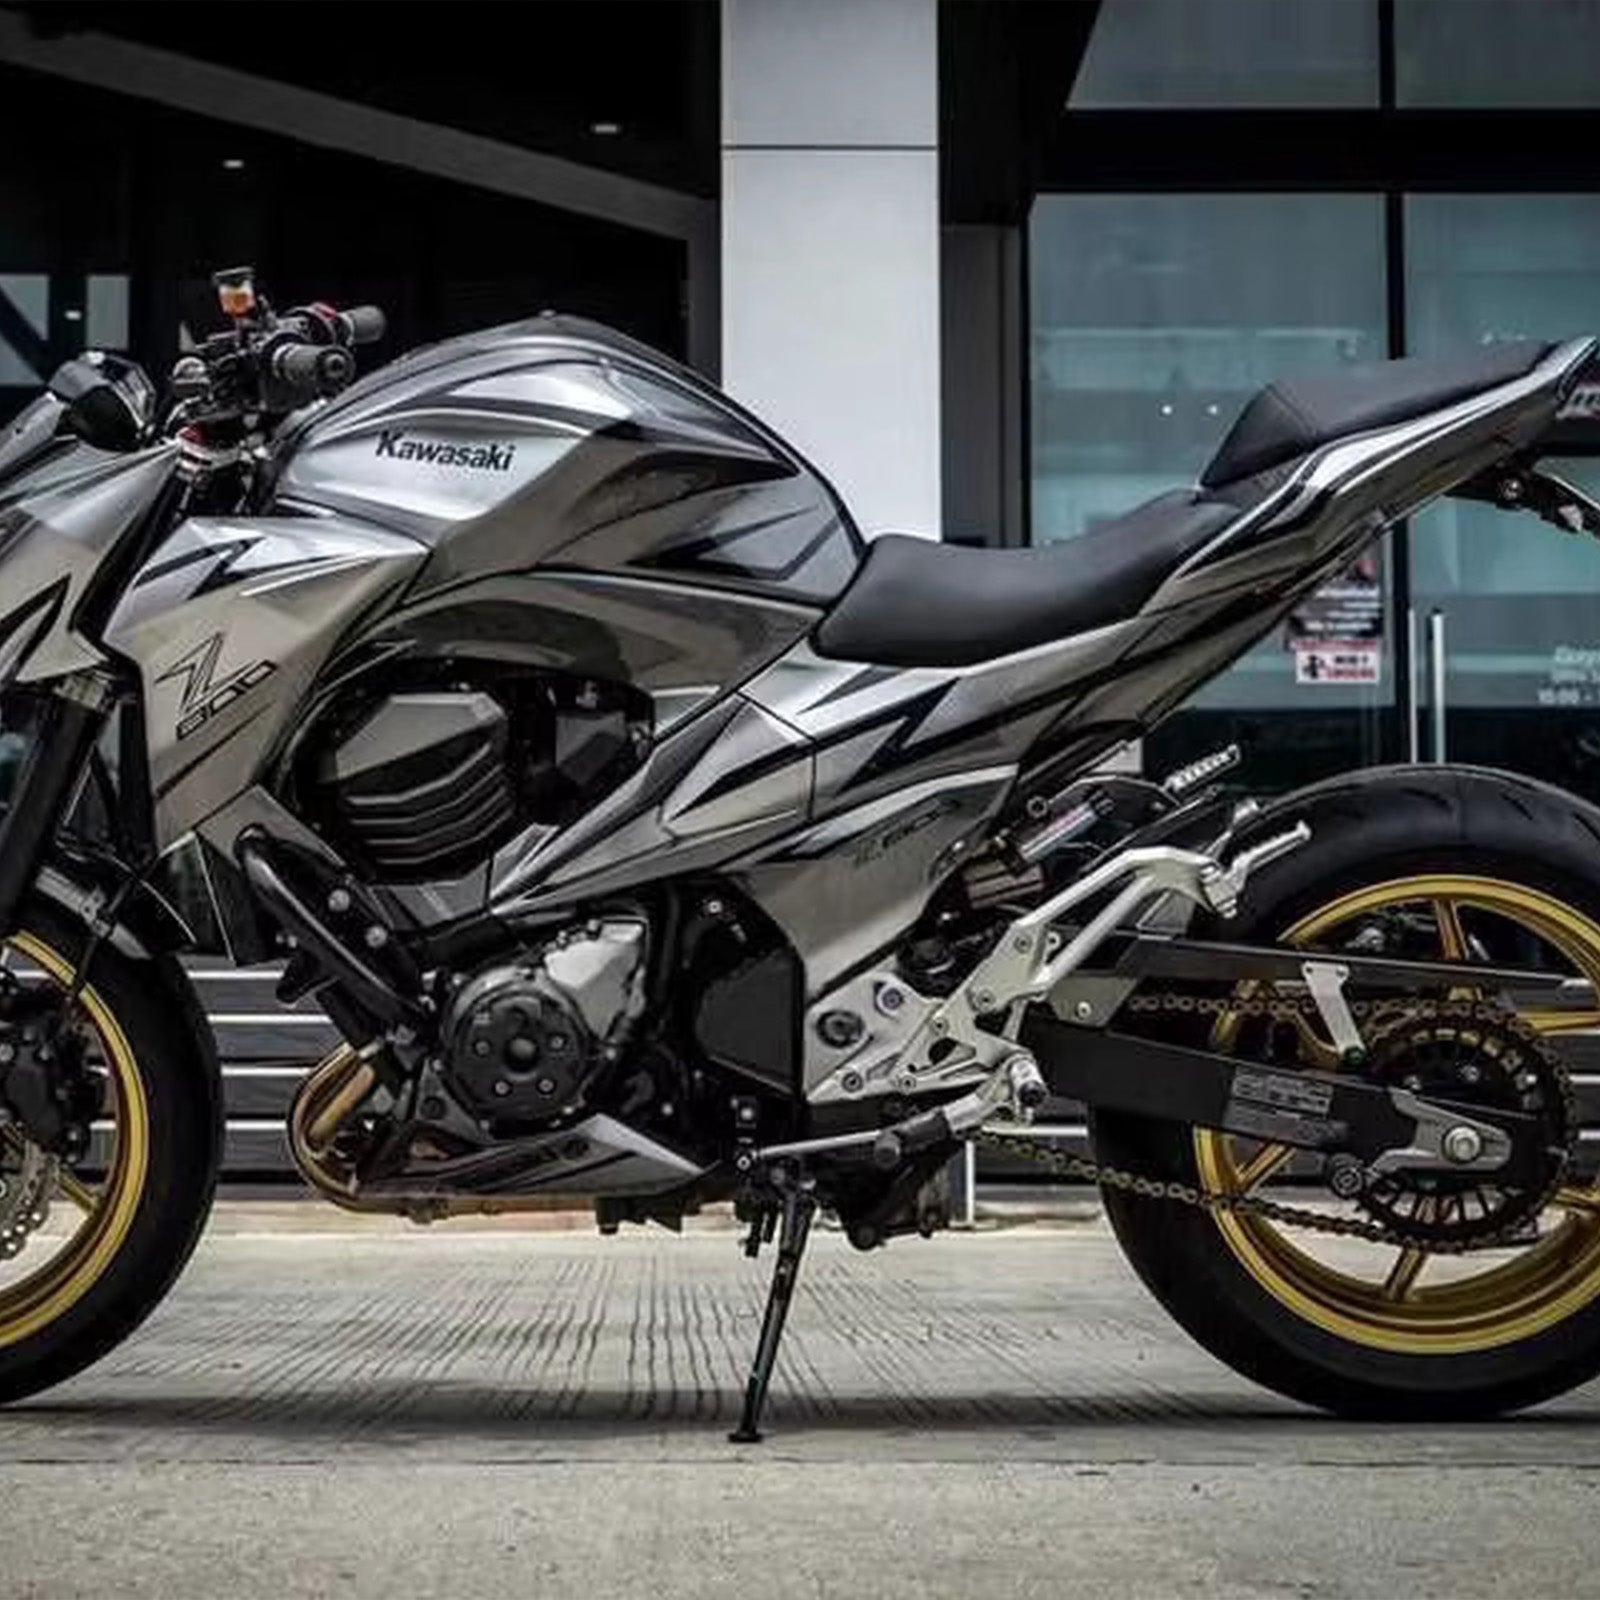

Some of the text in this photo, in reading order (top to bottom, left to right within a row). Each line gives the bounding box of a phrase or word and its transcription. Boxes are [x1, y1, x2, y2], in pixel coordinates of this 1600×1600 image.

[375, 430, 516, 471] Kawasaki
[154, 632, 257, 714] Z
[176, 660, 278, 740] 800
